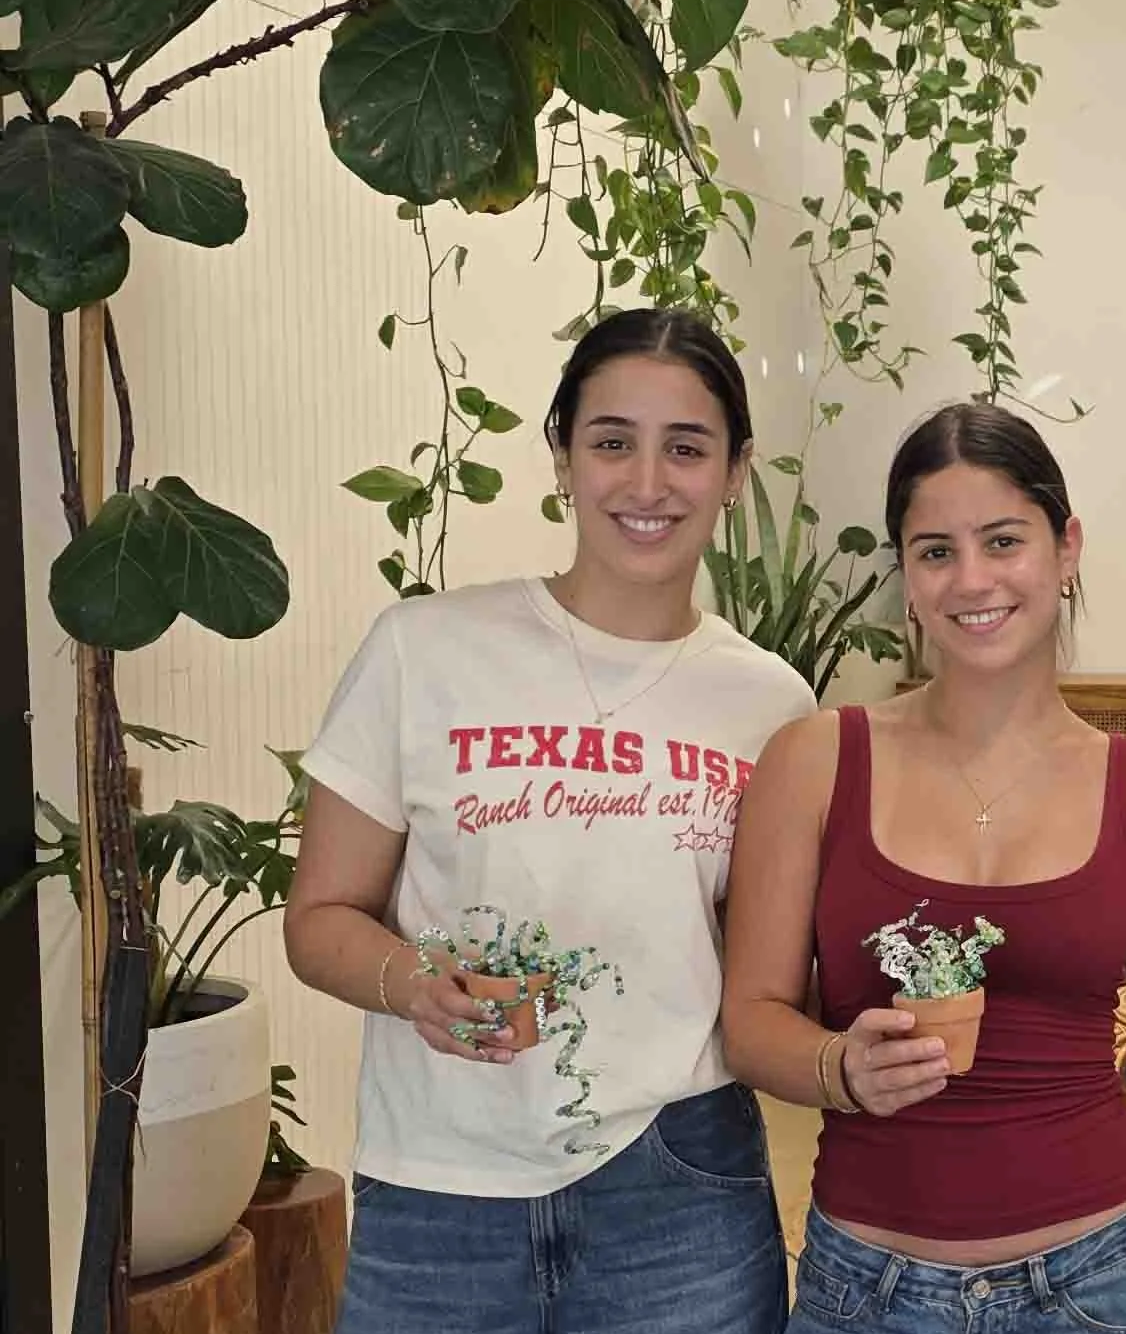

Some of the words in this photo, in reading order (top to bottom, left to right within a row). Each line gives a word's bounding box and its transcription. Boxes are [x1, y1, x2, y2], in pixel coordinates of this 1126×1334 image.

[450, 726, 644, 774] TEXAS
[455, 780, 532, 835] Ranch
[543, 780, 651, 830] Original
